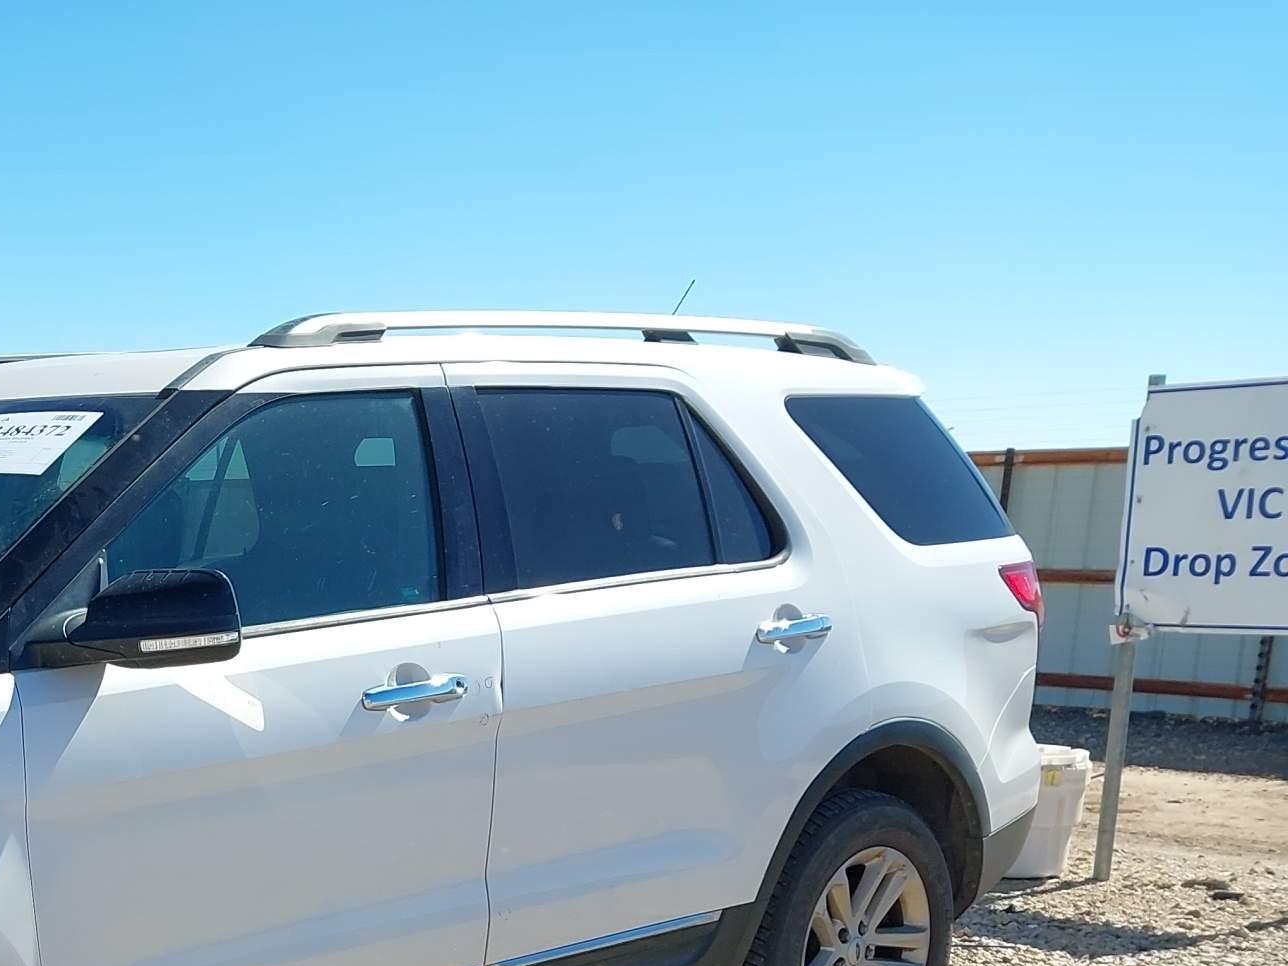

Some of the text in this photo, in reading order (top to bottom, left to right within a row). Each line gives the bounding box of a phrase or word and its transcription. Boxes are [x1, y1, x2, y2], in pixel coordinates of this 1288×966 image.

[1143, 434, 1288, 471] Progres
[1218, 487, 1284, 519] VIC
[1143, 547, 1237, 584] Drop
